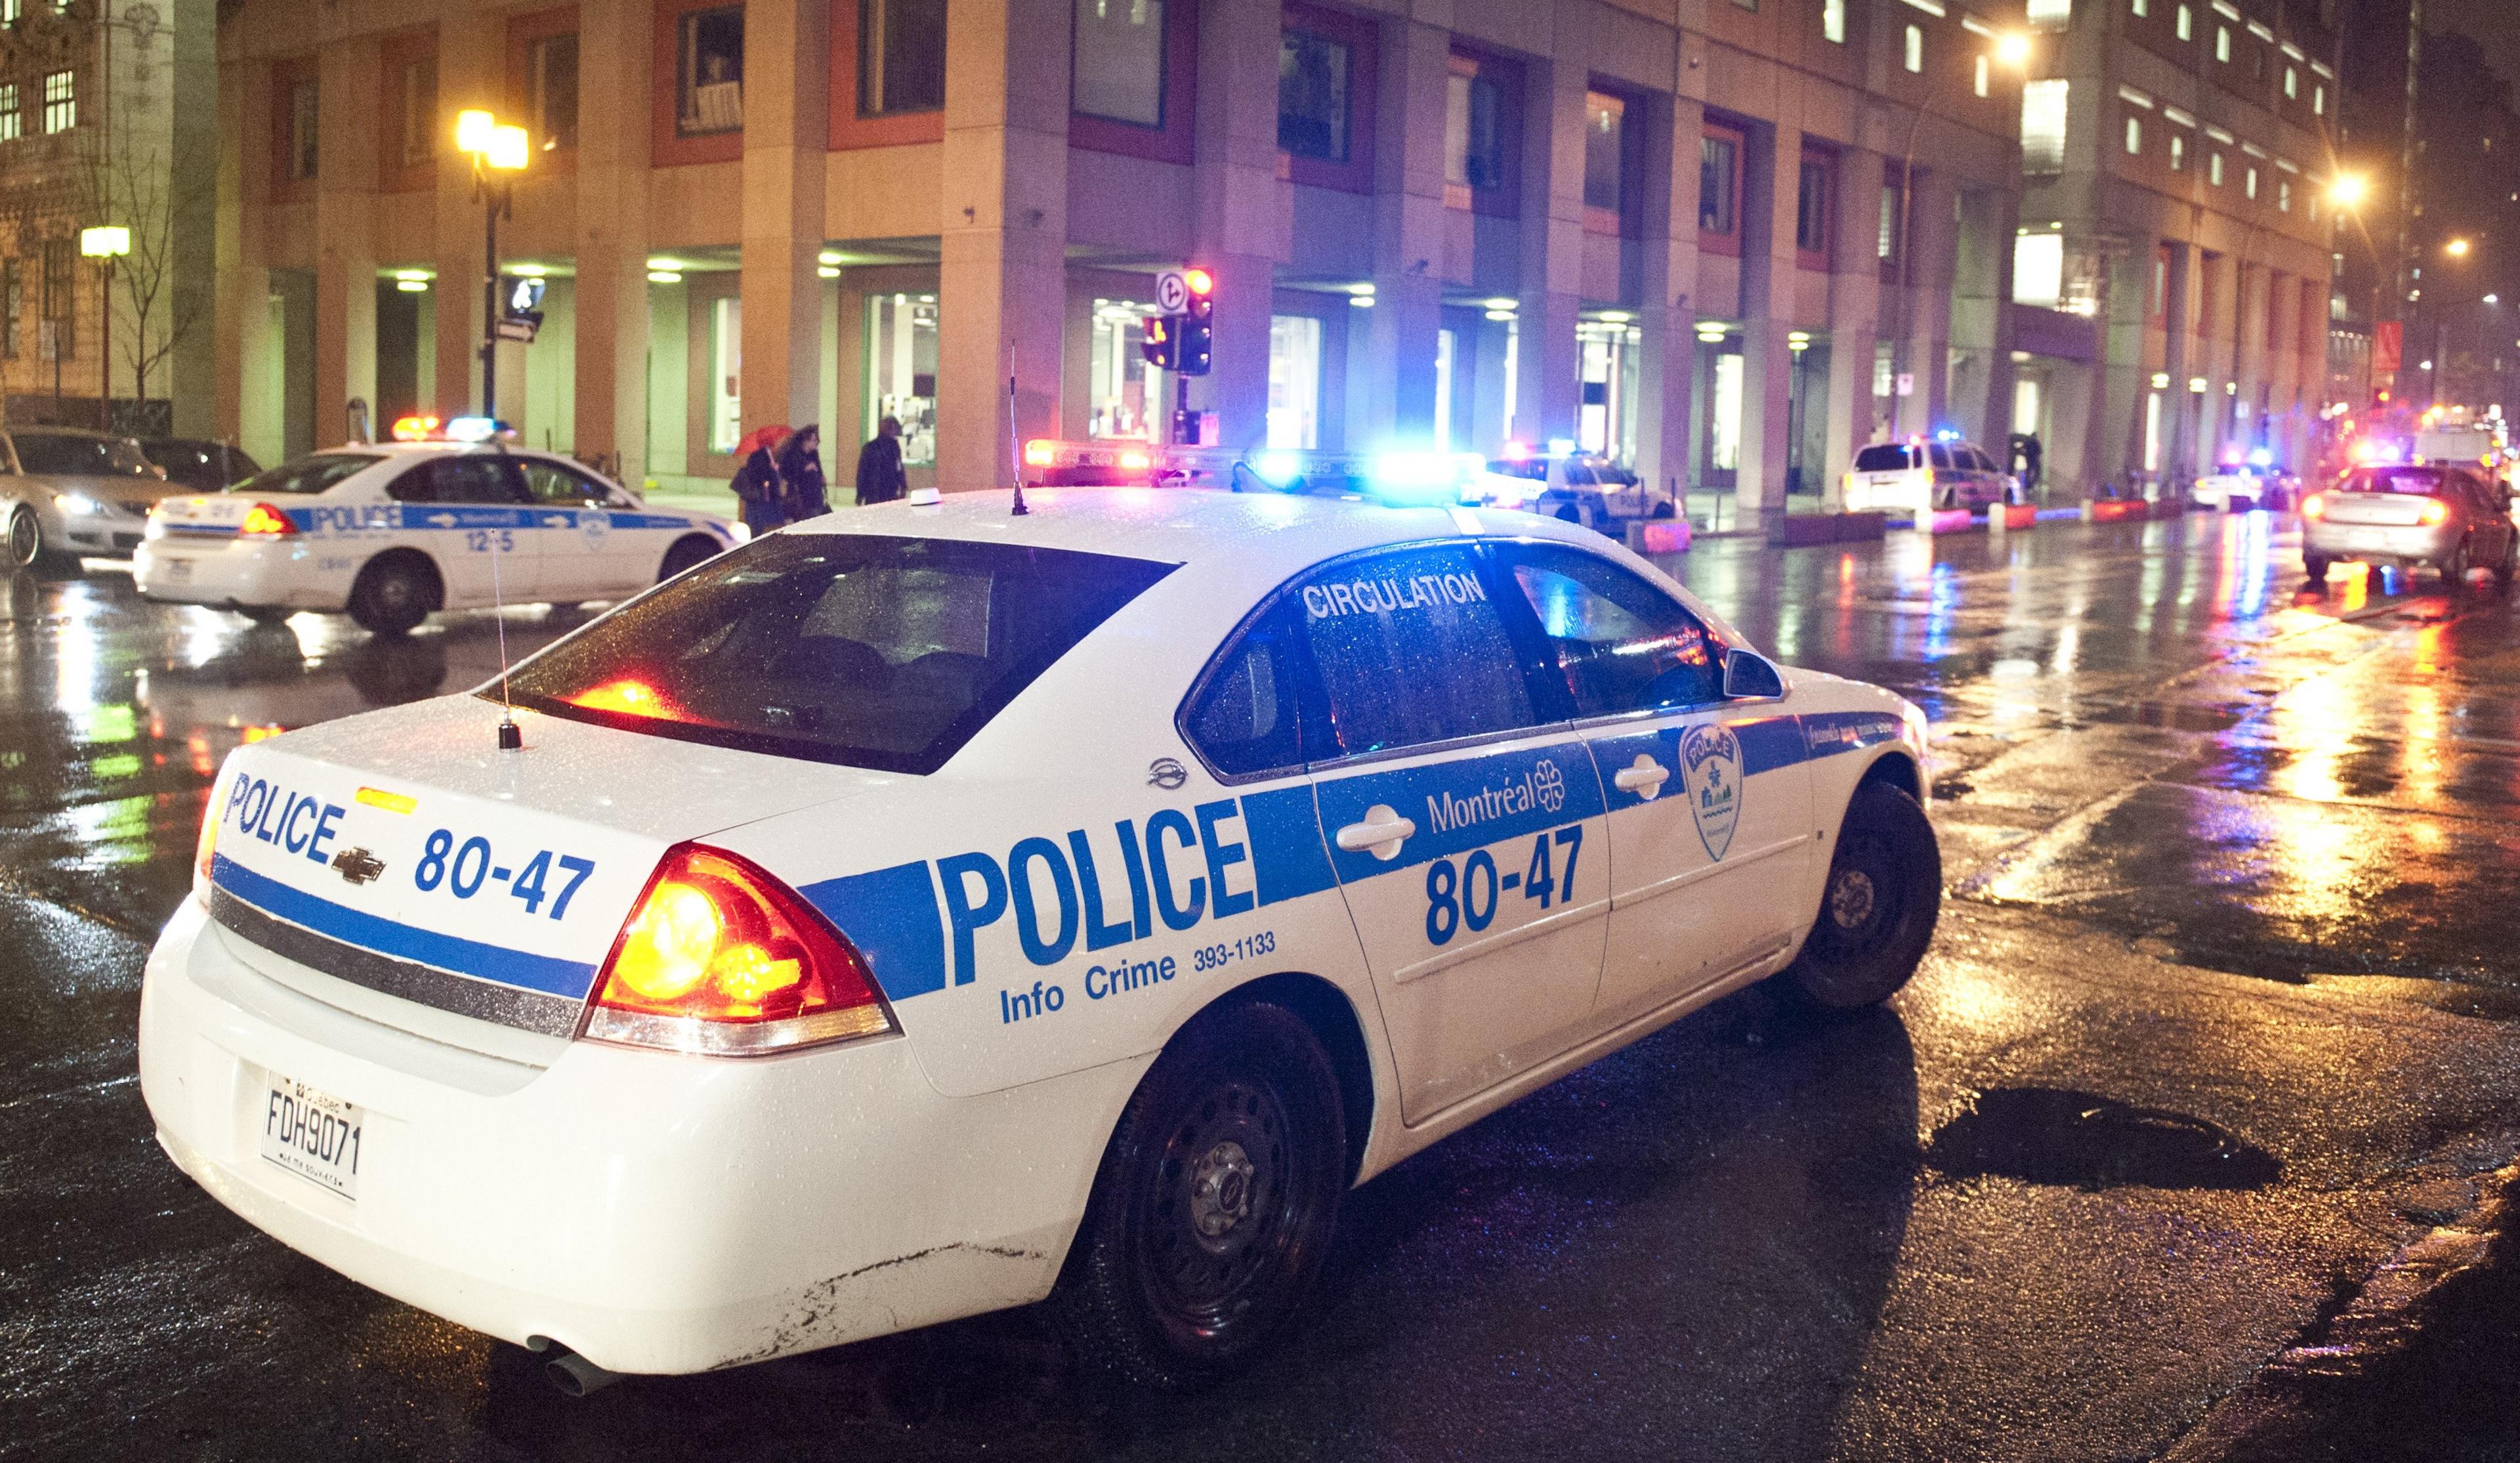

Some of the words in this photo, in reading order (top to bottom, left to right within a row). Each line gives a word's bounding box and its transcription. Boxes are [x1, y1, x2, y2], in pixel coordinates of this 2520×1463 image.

[312, 505, 402, 531] POLICE
[1303, 573, 1486, 618] CIRCULATION
[1690, 737, 1729, 763] POLICE
[223, 773, 345, 865] POLICE
[1427, 772, 1536, 834] Montréal
[415, 829, 595, 920] 80-47
[936, 798, 1255, 987] POLICE
[1426, 824, 1583, 946] 80-47
[1001, 982, 1064, 1024] Info
[1085, 956, 1175, 1000] Crime
[1194, 931, 1275, 971] 393-1133
[268, 1090, 360, 1174] FDH9071
